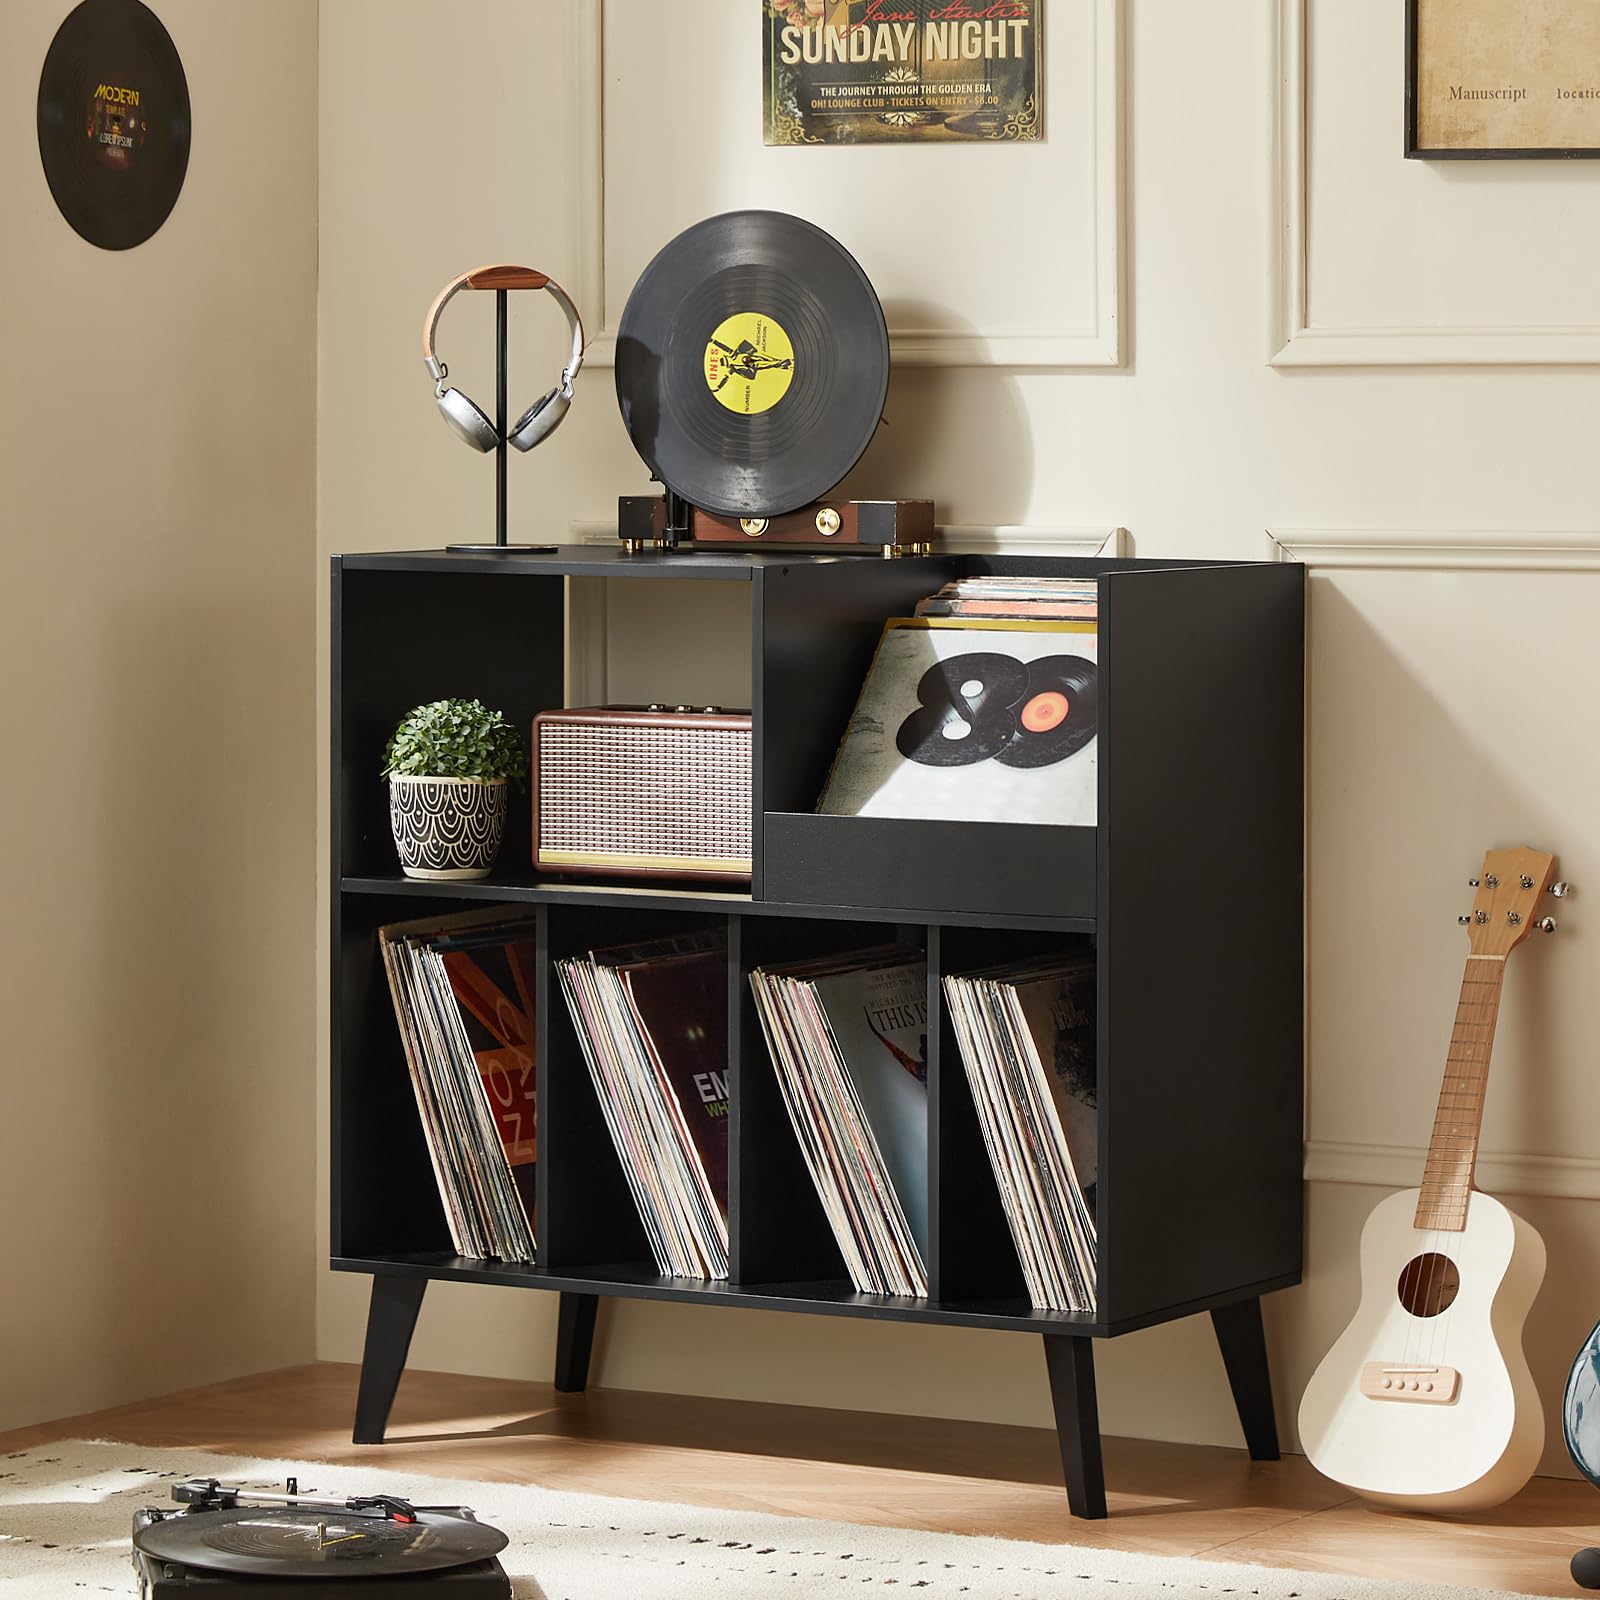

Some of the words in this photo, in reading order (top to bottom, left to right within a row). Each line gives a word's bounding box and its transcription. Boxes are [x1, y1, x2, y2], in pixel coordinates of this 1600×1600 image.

[839, 0, 918, 39] Jane
[780, 22, 916, 64] SUNDAY
[926, 19, 1029, 60] NIGHT
[94, 84, 139, 106] MODERN
[820, 87, 837, 97] THE
[838, 86, 876, 96] JOURNEY
[877, 84, 919, 95] THROUGH
[920, 84, 937, 94] THE
[938, 83, 973, 94] GOLDEN
[974, 82, 992, 93] ERA
[1450, 84, 1527, 102] Manuscript
[811, 99, 826, 109] OH!
[828, 98, 861, 108] LOUNGE
[863, 97, 885, 108] CLUB
[890, 96, 924, 107] TICKETS
[925, 96, 938, 106] ON
[940, 95, 968, 105] ENTRY
[974, 95, 999, 105] $6.00
[709, 347, 719, 380] ONES
[872, 1004, 916, 1031] THIS
